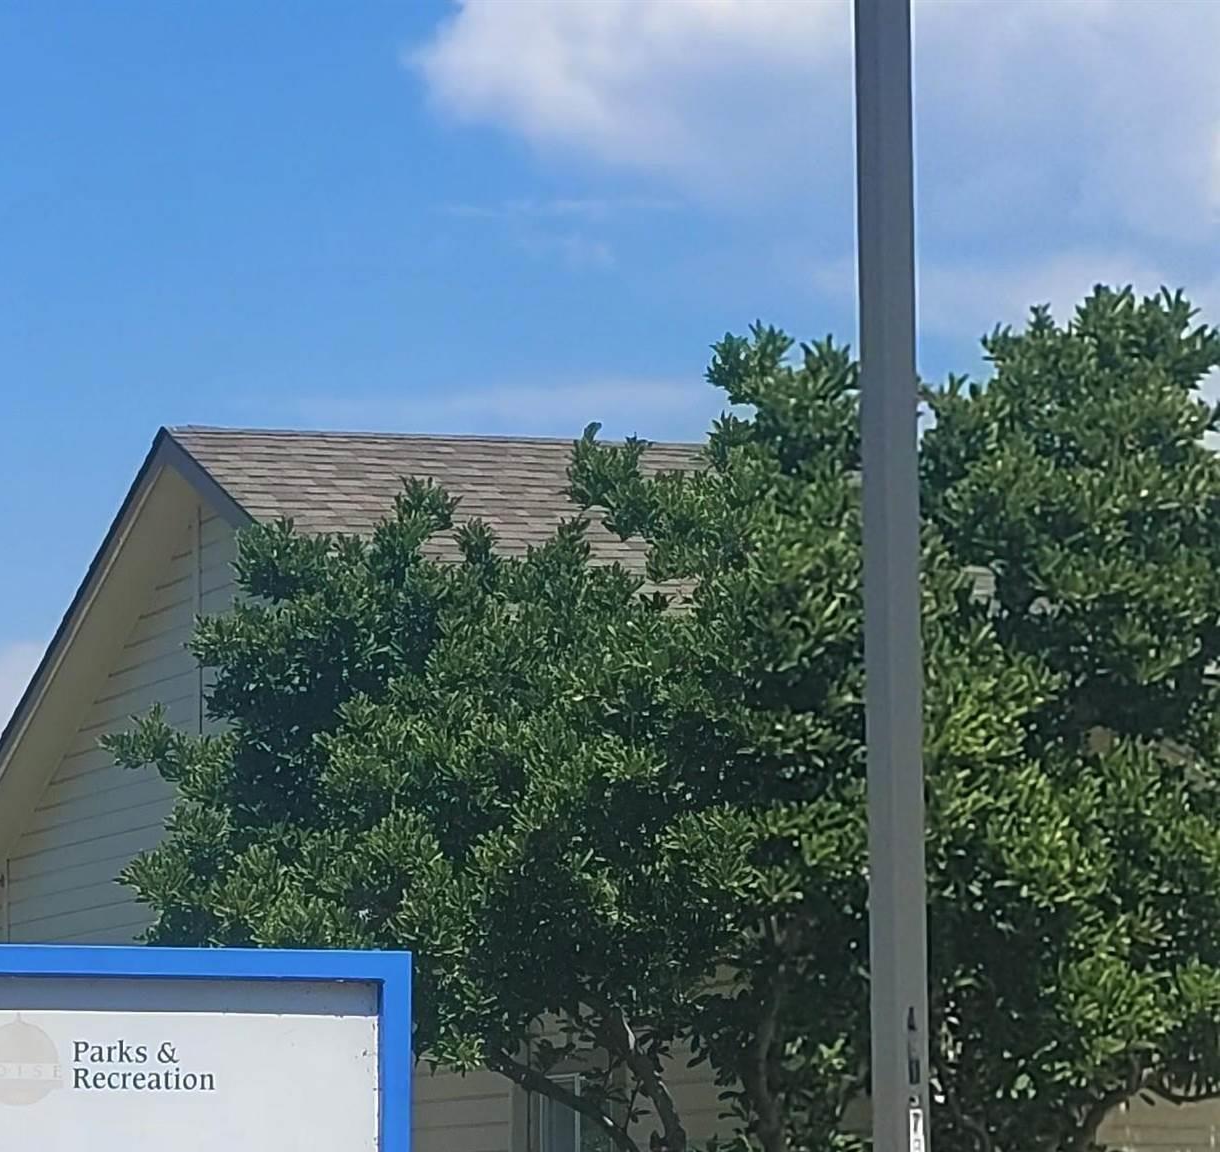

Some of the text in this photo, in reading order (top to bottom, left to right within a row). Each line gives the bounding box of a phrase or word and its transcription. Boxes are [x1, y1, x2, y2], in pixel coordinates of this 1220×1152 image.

[73, 1039, 180, 1064] Parks &
[73, 1067, 215, 1091] Recreation
